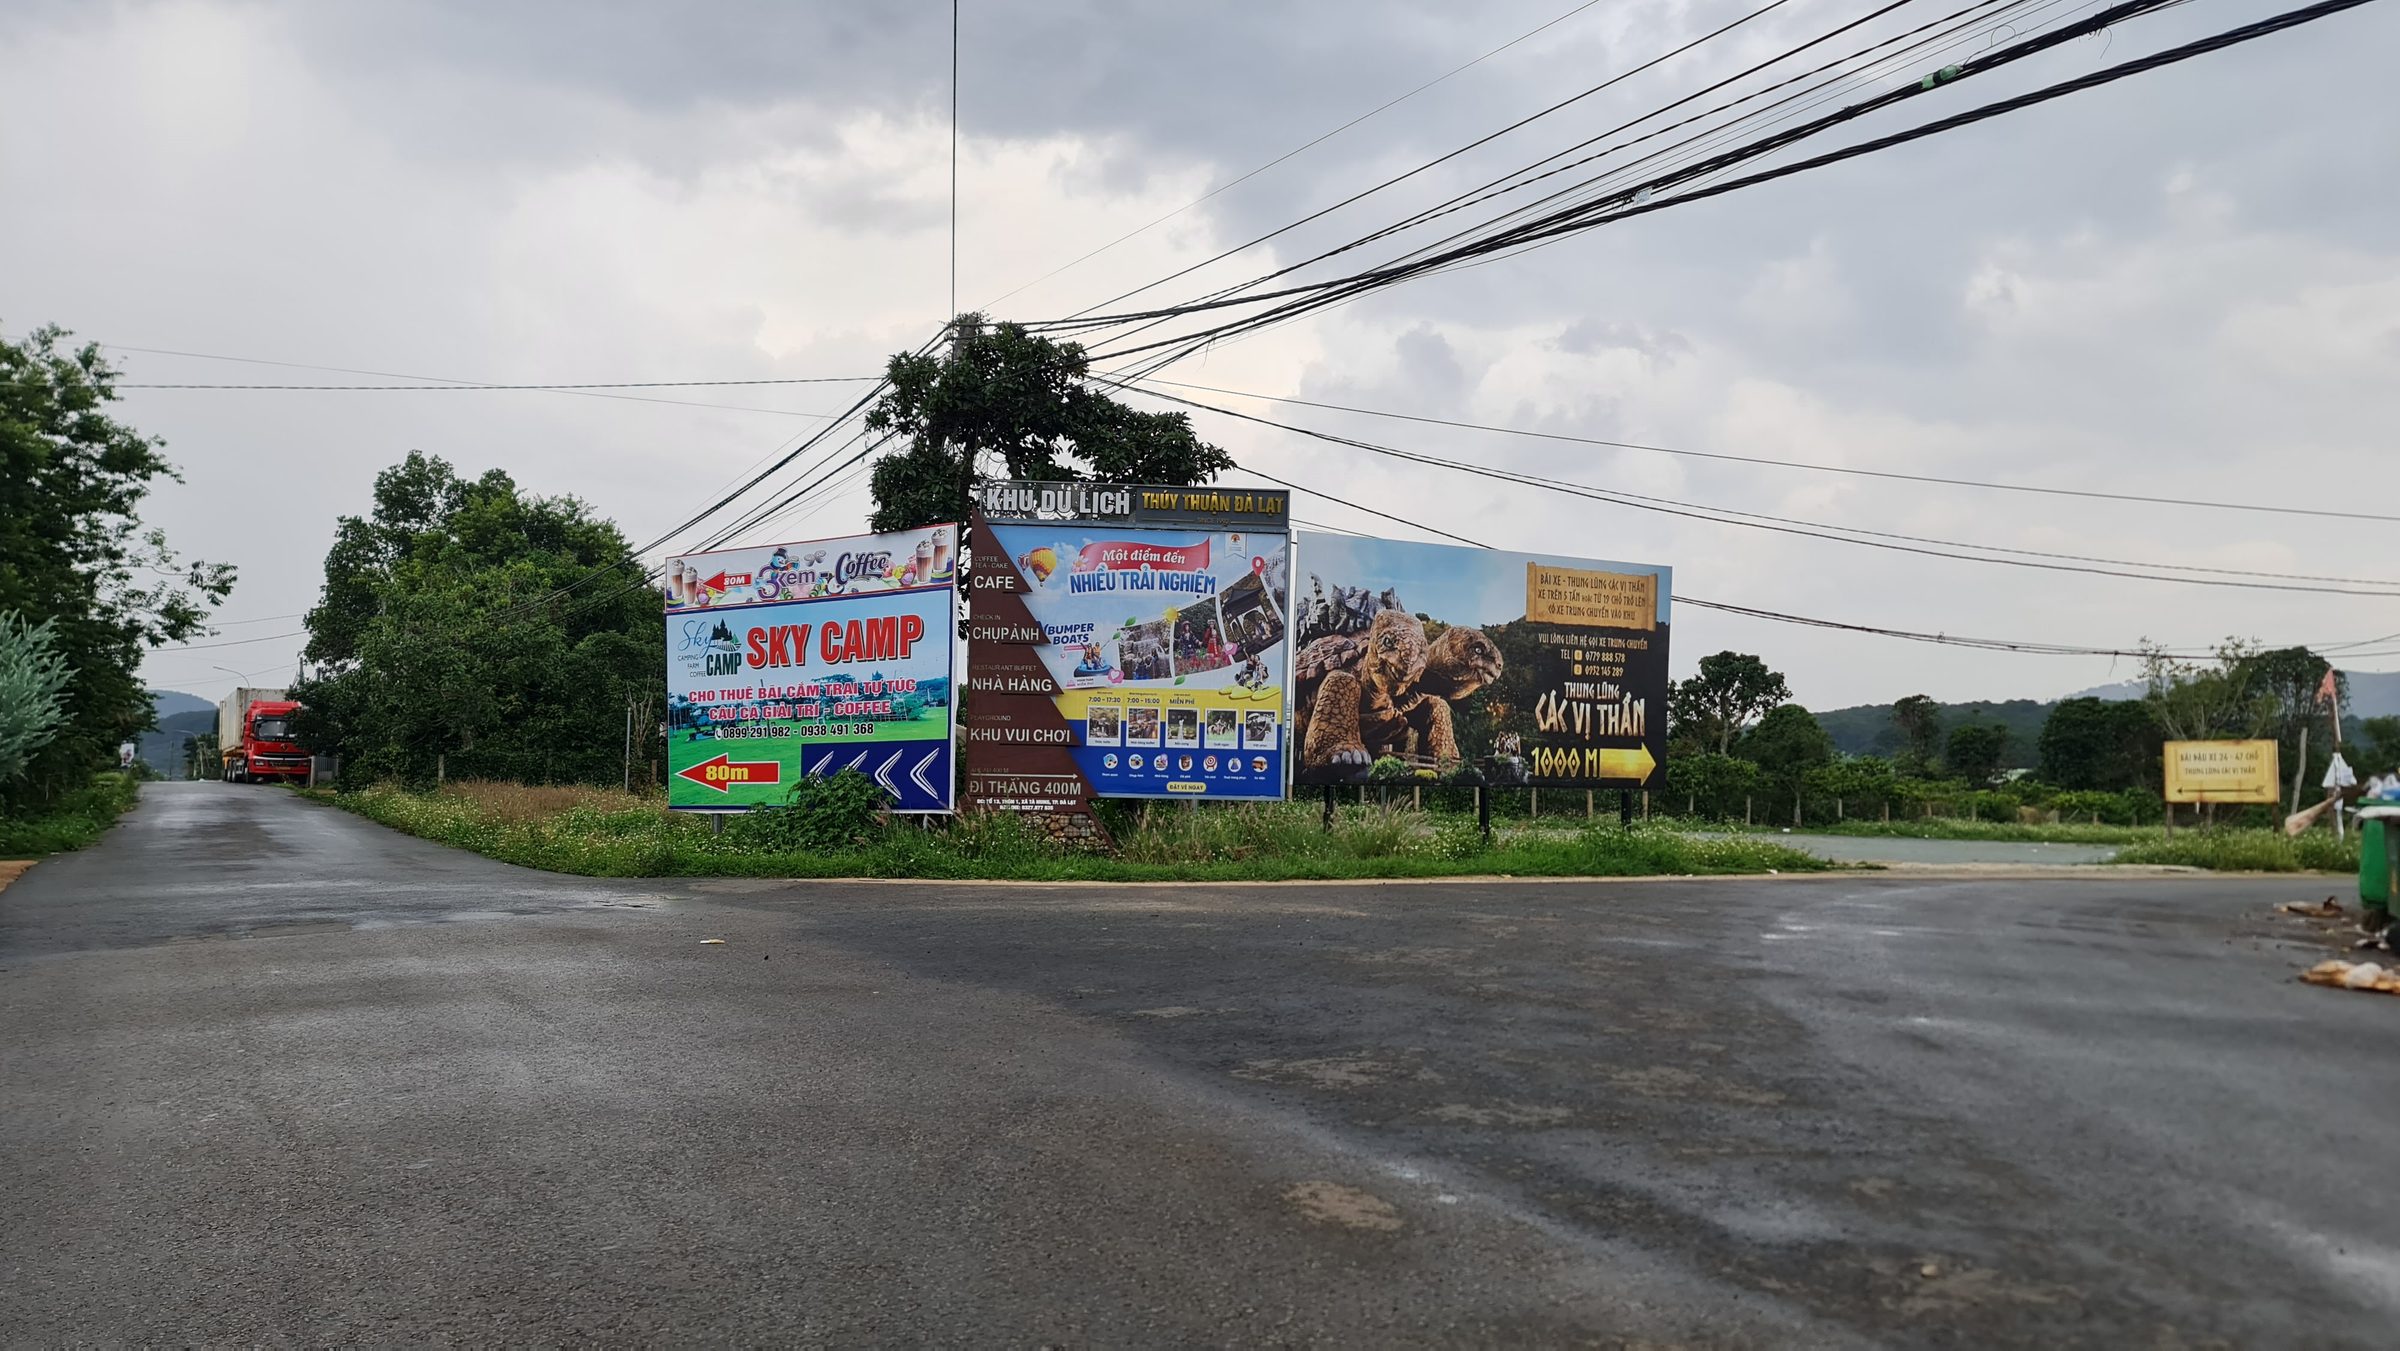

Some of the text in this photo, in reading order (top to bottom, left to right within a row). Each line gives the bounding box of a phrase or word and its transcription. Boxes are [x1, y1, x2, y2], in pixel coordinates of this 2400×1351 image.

[986, 488, 1034, 511] KHU
[1040, 490, 1072, 512] DU
[1142, 490, 1283, 516] THÚY THUẬN ĐÀ LẠT
[1102, 548, 1186, 564] Một điểm đến
[835, 551, 891, 585] Coffee
[723, 575, 745, 586] 80M
[974, 576, 1014, 589] CAFE
[1070, 564, 1216, 599] NHIỀU TRẢI NGHIỆM
[1553, 575, 1561, 586] XE
[1567, 576, 1589, 589] THUNG
[1608, 578, 1619, 591] CÁC
[1537, 589, 1546, 600] XE
[1603, 594, 1610, 604] 19
[1556, 605, 1564, 614] XE
[1566, 605, 1586, 617] TRUNG
[1048, 623, 1094, 635] BUMPER
[678, 620, 717, 659] Sky
[746, 614, 925, 670] SKY CAMP
[1053, 634, 1089, 645] BOATS
[1538, 633, 1549, 643] VUI
[1599, 637, 1606, 647] XE
[1607, 637, 1625, 649] TRUNG
[677, 653, 699, 661] CAMPING
[1560, 649, 1626, 663] TEL 0779 888 578
[706, 652, 742, 677] CAMP
[1612, 666, 1624, 677] 289
[689, 690, 715, 702] CHO
[720, 686, 753, 700] THUÊ
[758, 685, 782, 699] BÃI
[825, 682, 858, 698] TRẠI
[863, 680, 883, 697] TỰ
[887, 677, 916, 693] TÚC
[972, 674, 1052, 692] NHÀ HÀNG
[1564, 681, 1595, 698] THUNG
[709, 705, 736, 720] CÂU
[740, 704, 759, 719] CÁ
[763, 702, 792, 718] GIẢI
[797, 701, 819, 717] TRÍ
[834, 700, 891, 715] COFFEE
[1535, 689, 1568, 733] CÁC
[1572, 701, 1591, 740] VỊ
[723, 728, 747, 739] 0899
[750, 727, 768, 738] 291
[771, 726, 790, 737] 982
[801, 725, 827, 736] 0938
[830, 725, 849, 735] 491
[854, 724, 873, 734] 368
[970, 728, 1070, 742] KHU VUI CHƠI
[1531, 746, 1598, 778] 1000 M
[705, 765, 749, 780] 80m
[1044, 782, 1081, 795] 400M
